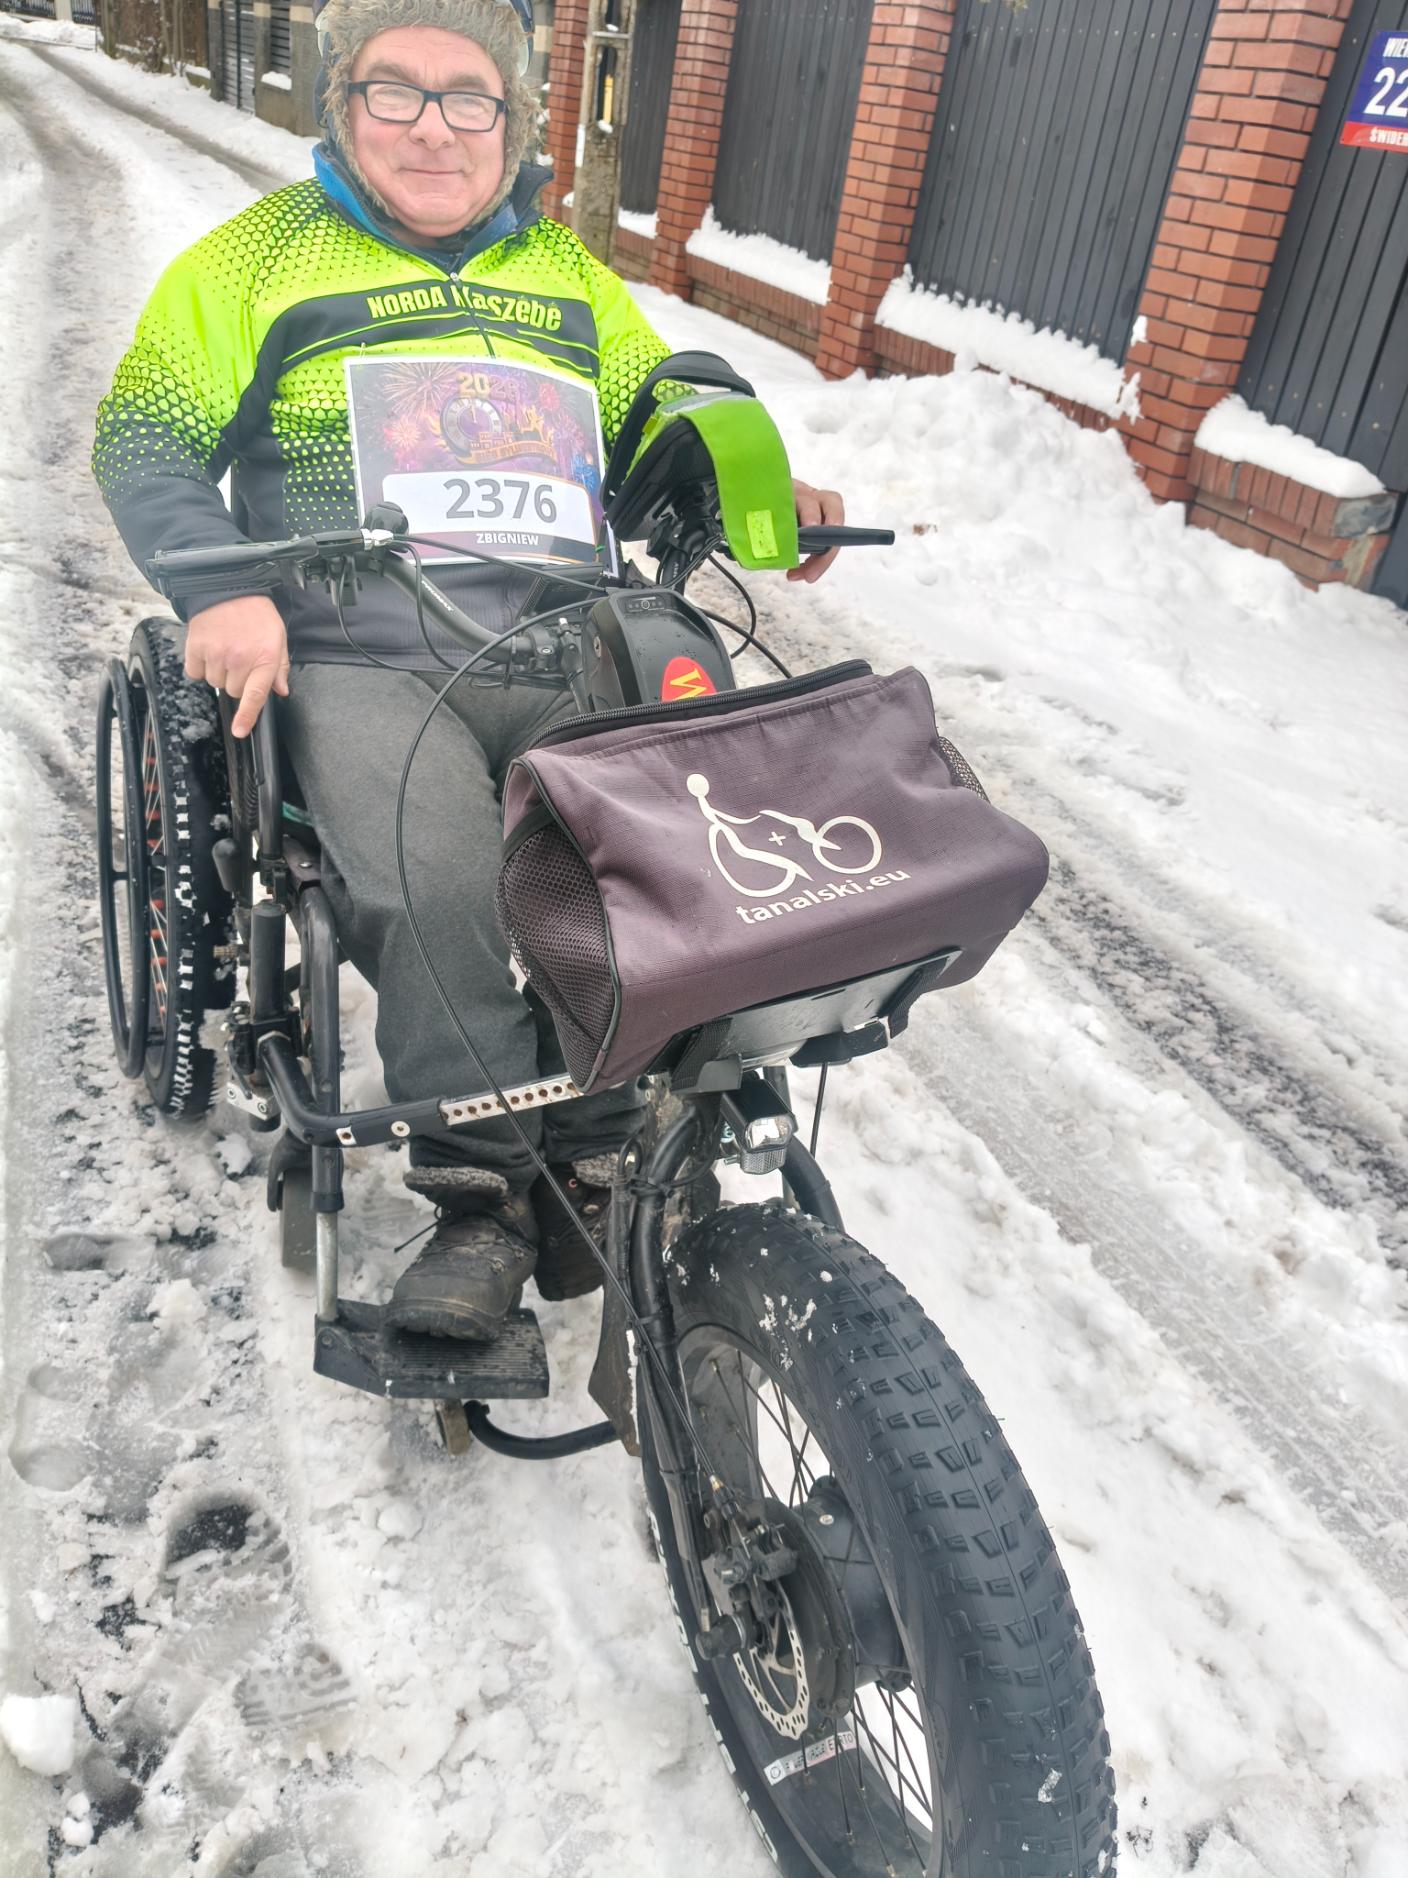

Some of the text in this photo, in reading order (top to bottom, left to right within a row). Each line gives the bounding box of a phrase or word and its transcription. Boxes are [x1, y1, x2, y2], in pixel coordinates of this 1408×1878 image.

[366, 285, 448, 319] NORDA
[442, 478, 557, 524] 2376
[476, 532, 539, 546] ZBIGNIEW
[736, 868, 911, 924] tanalski.eu
